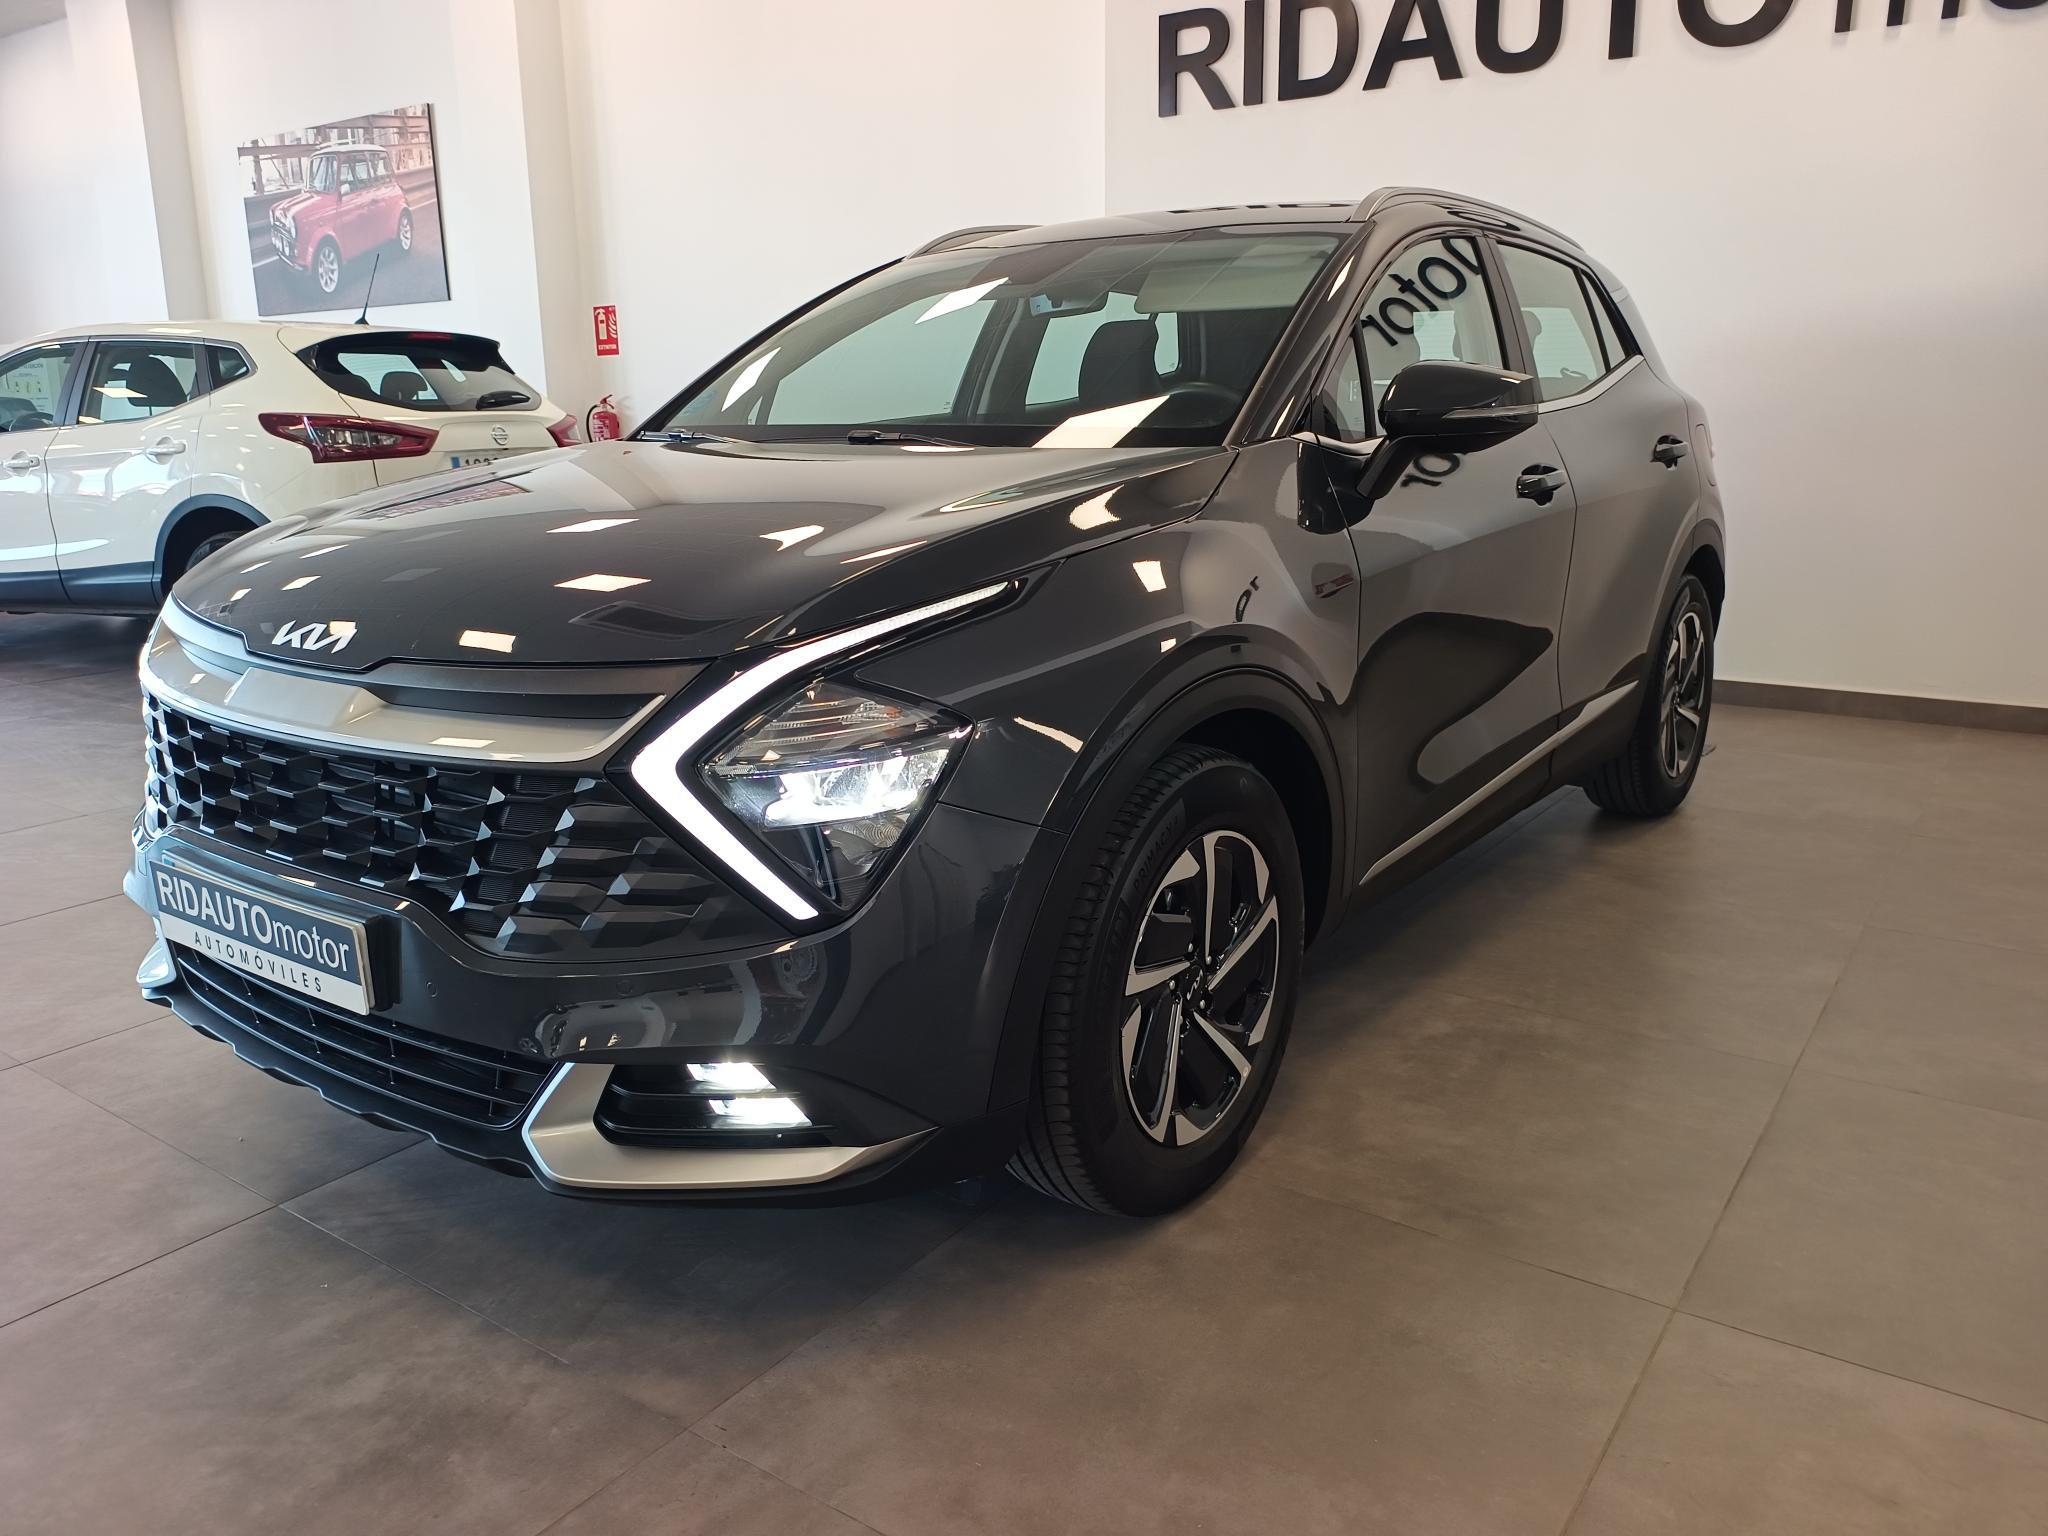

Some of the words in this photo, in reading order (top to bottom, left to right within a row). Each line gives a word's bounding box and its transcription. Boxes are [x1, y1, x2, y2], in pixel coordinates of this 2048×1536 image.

[1158, 0, 2048, 118] RIDAU
[156, 871, 349, 973] RIDAUTOmotor
[194, 930, 322, 994] AUTOMÓVILES
